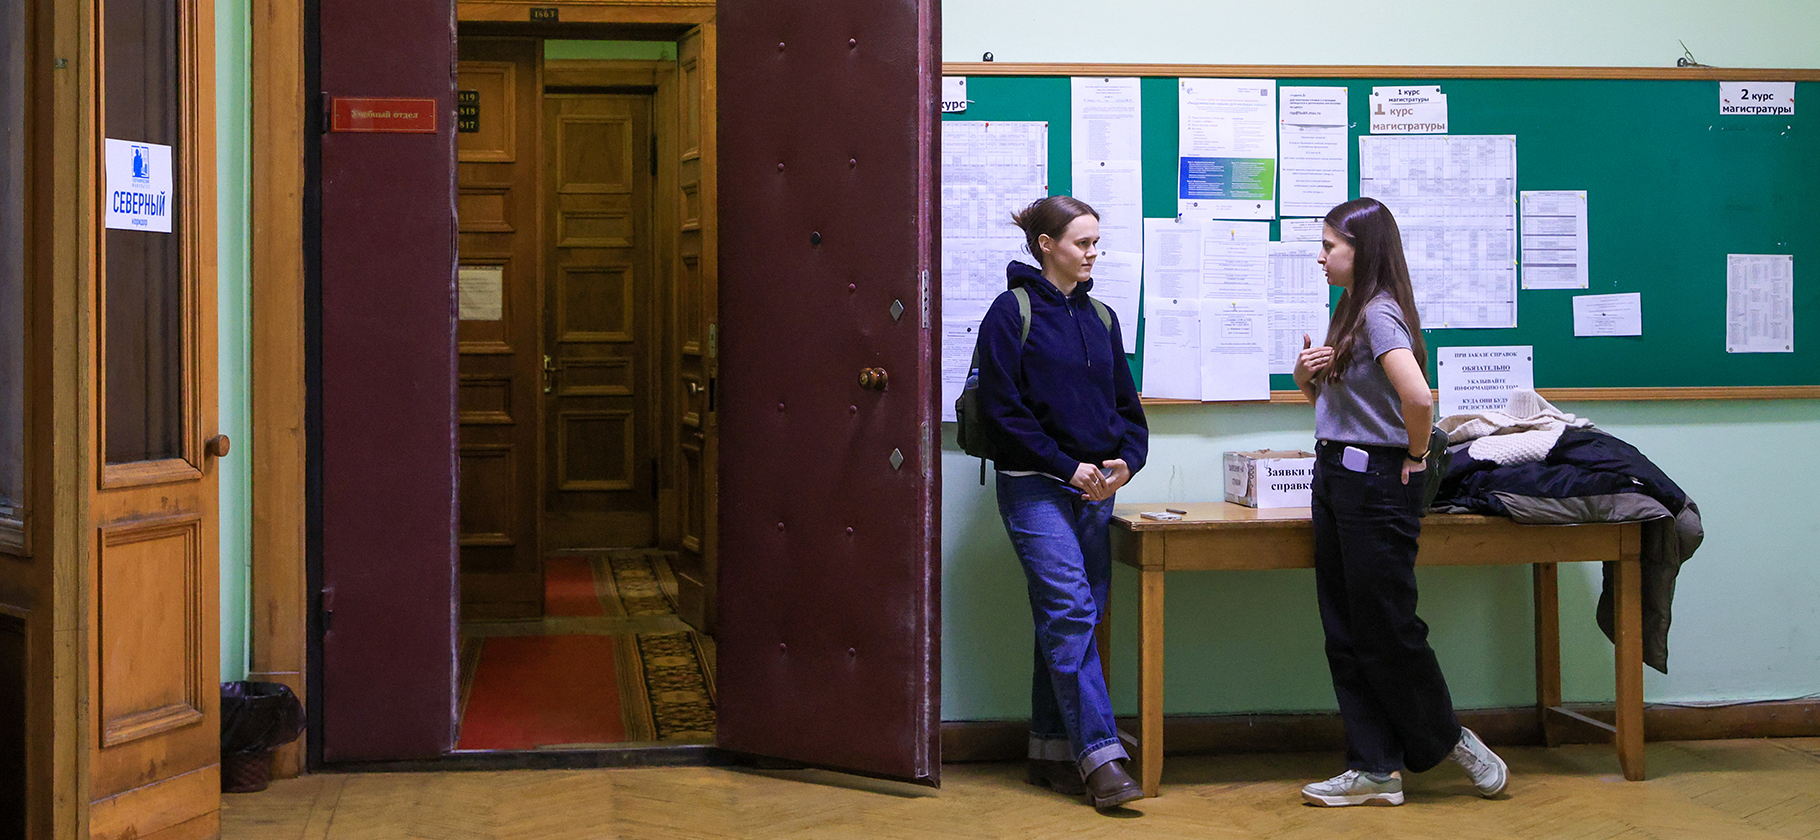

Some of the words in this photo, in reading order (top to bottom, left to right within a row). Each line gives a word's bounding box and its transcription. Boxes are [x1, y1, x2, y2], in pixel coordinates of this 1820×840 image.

[1741, 88, 1749, 100] 2
[1751, 93, 1774, 102] курс
[1390, 108, 1414, 117] курс
[1722, 105, 1792, 115] магистратуры
[393, 111, 418, 119] отдел
[1372, 123, 1445, 132] магистратуры
[113, 190, 165, 216] СЕВЕРНЫЙ
[1266, 468, 1304, 477] Заявки
